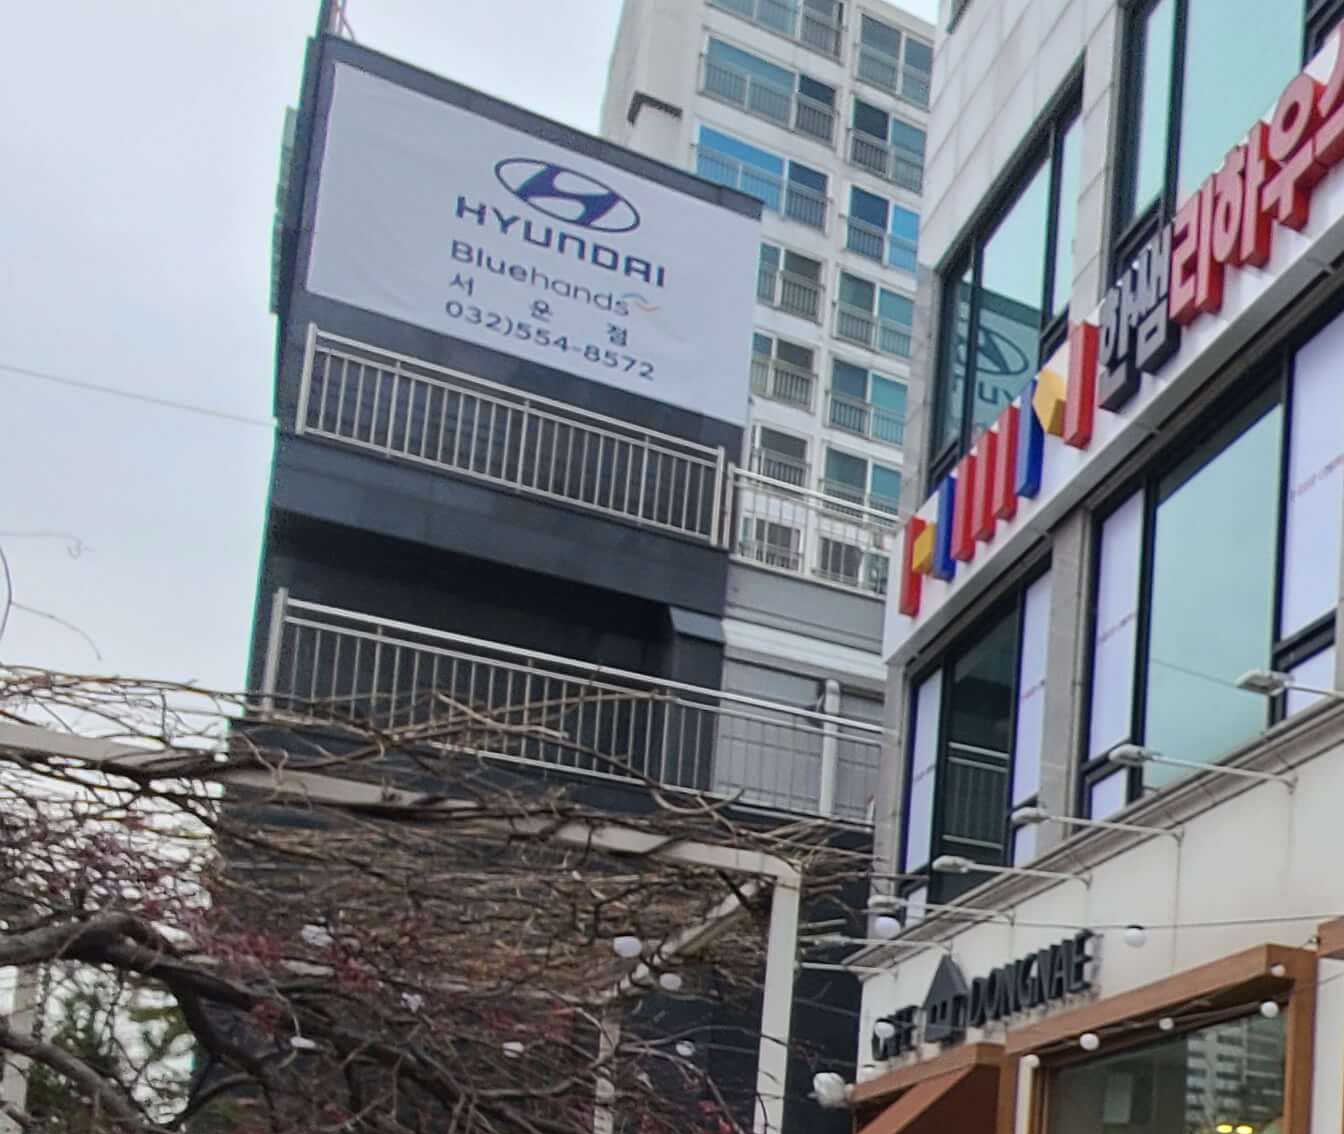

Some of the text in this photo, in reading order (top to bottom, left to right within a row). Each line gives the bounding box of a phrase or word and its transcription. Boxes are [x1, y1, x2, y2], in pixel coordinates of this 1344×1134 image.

[451, 239, 630, 317] Bluehands
[455, 195, 666, 288] HYUNDAI
[445, 300, 656, 381] 032)554-8572
